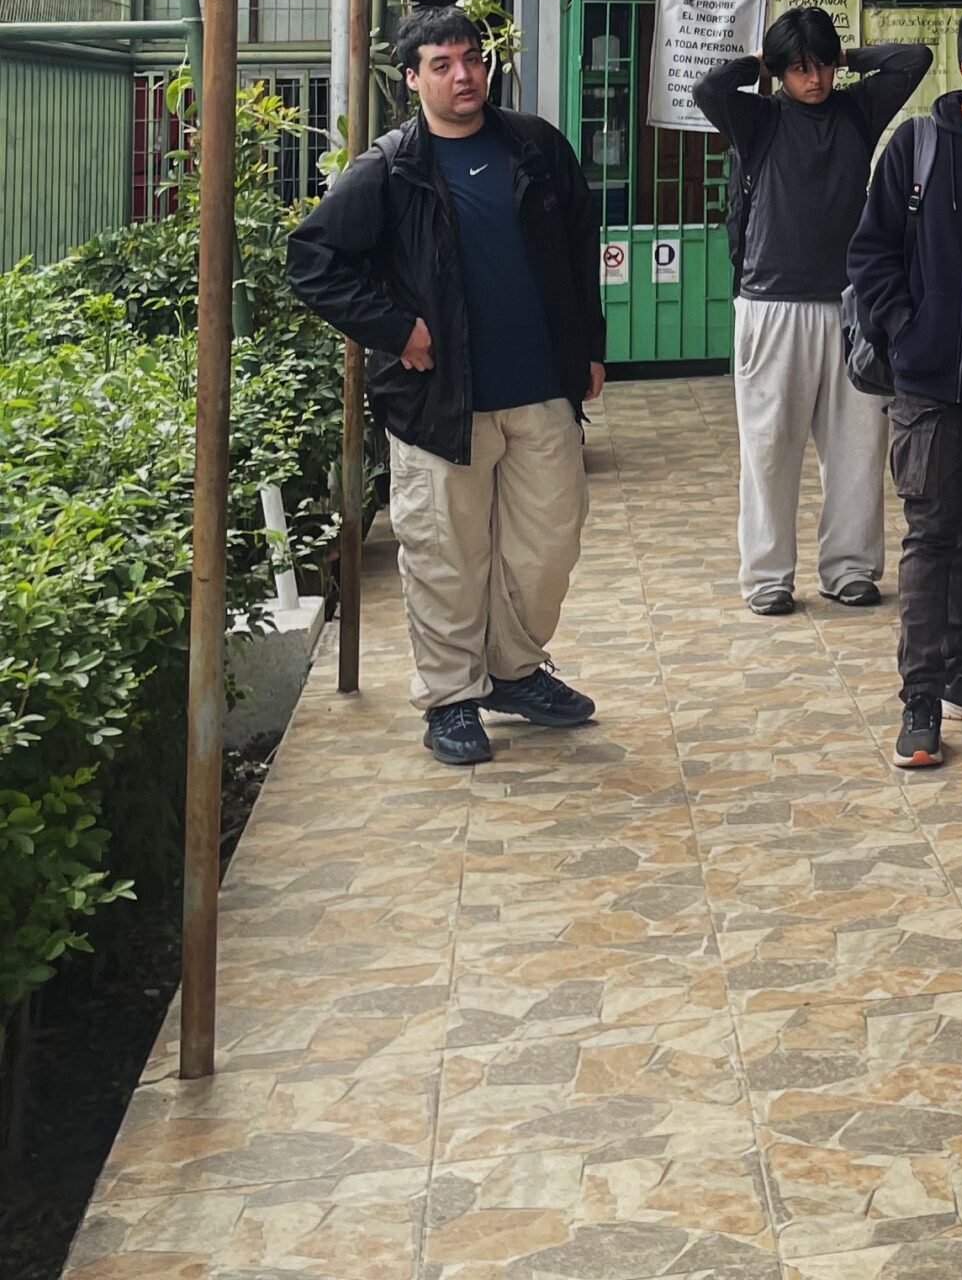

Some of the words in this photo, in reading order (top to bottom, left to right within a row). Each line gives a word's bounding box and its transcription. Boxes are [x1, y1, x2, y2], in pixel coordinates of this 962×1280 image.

[696, 0, 736, 9] PROHIBE
[682, 11, 694, 21] EL
[696, 13, 736, 24] INGRESO
[679, 26, 693, 35] AL
[694, 27, 734, 38] RECINTO
[665, 38, 672, 47] A
[675, 39, 699, 49] TODA
[700, 43, 744, 53] PERSONA
[673, 54, 693, 64] CON
[668, 68, 681, 77] DE
[672, 98, 684, 107] DE
